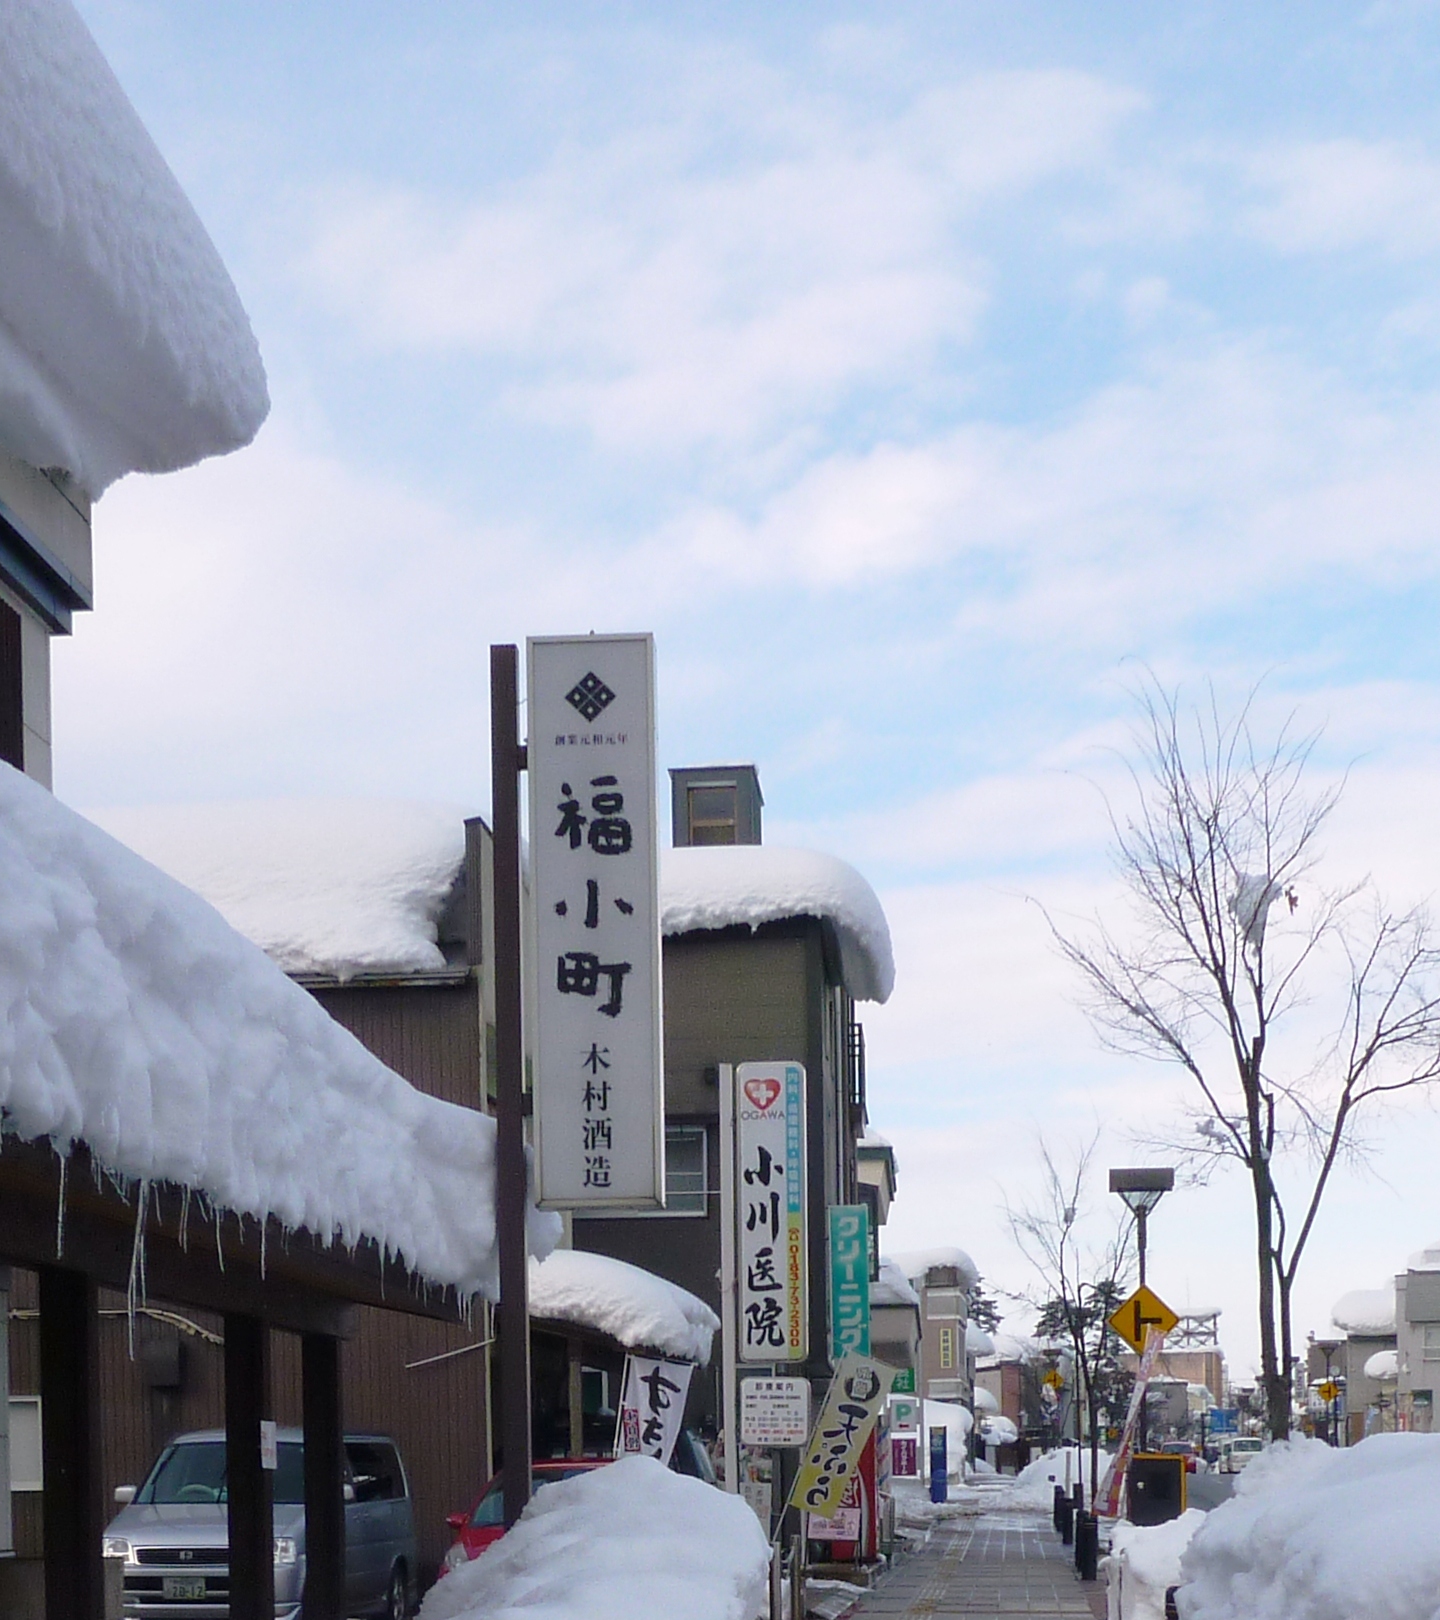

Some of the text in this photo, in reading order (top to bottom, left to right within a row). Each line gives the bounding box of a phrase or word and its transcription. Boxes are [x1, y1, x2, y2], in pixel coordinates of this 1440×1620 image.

[554, 775, 633, 1018] 福小町
[580, 1043, 612, 1188] 木村酒造
[741, 1110, 785, 1121] OGAWA
[743, 1145, 785, 1347] 小川医院
[789, 1245, 800, 1347] 0183-73-2300
[838, 1216, 867, 1351] クリーニング
[896, 1404, 912, 1422] P
